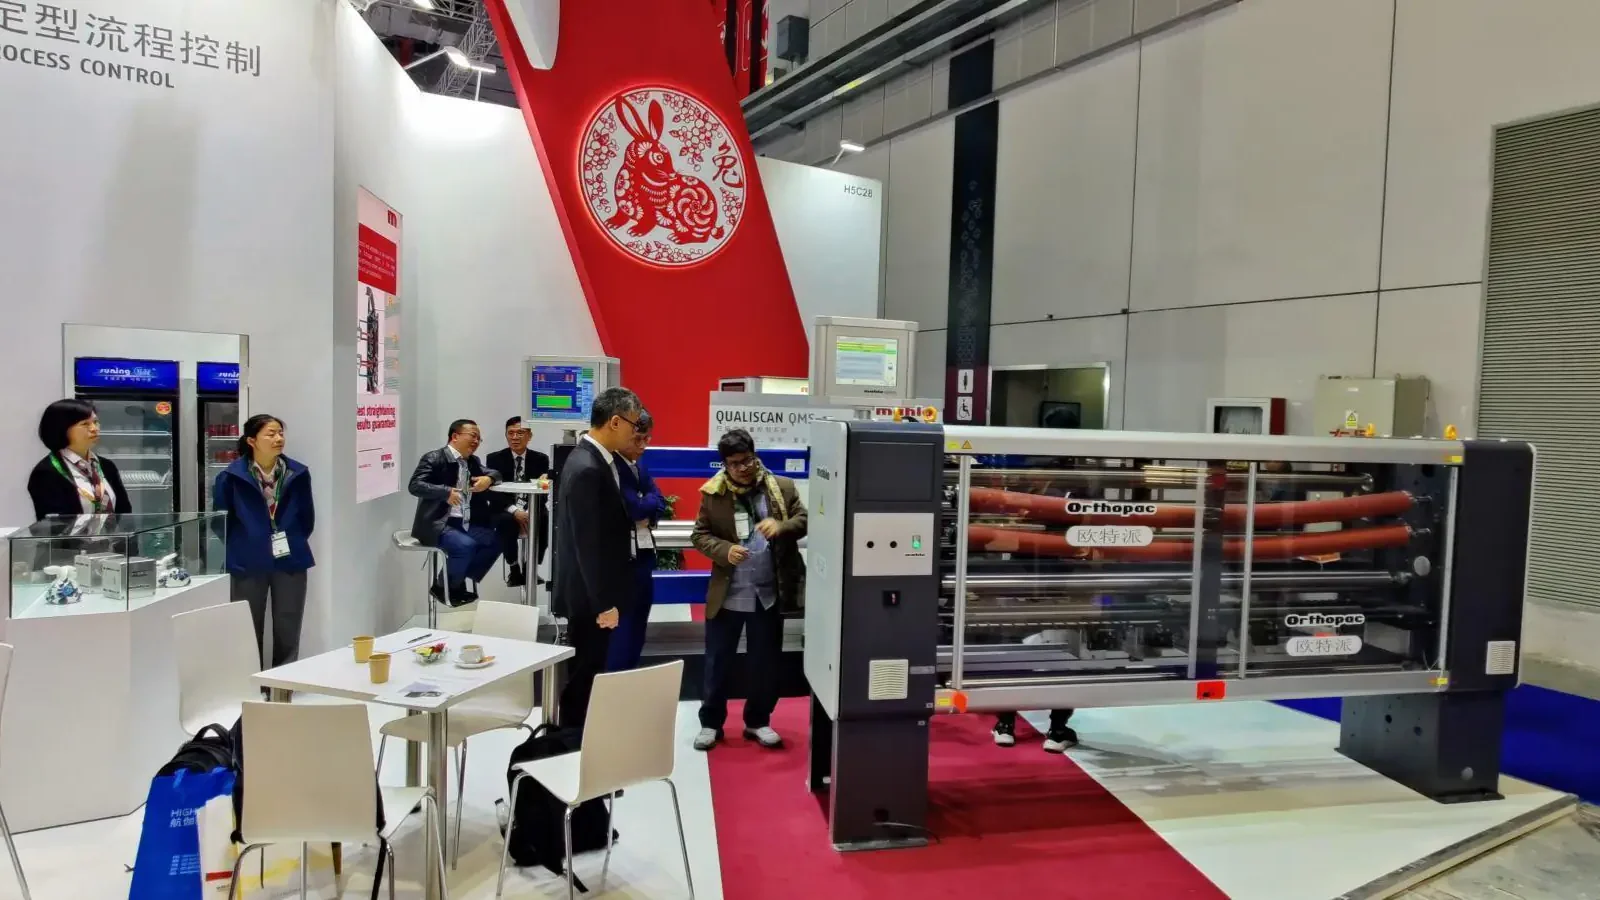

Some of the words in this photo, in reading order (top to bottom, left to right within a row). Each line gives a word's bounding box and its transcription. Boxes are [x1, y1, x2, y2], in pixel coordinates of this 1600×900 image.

[0, 0, 261, 77] 定型流程控制
[0, 44, 71, 71] OCESS
[80, 58, 175, 89] CONTROL
[844, 184, 873, 198] H5C28
[716, 410, 784, 425] QUALISCAN
[788, 412, 815, 426] QMS
[876, 407, 934, 417] mhl
[1067, 502, 1155, 515] Orthopac
[1077, 528, 1142, 545] 欧特派
[1286, 614, 1364, 626] Orthopac
[1296, 638, 1353, 653] 欧特派
